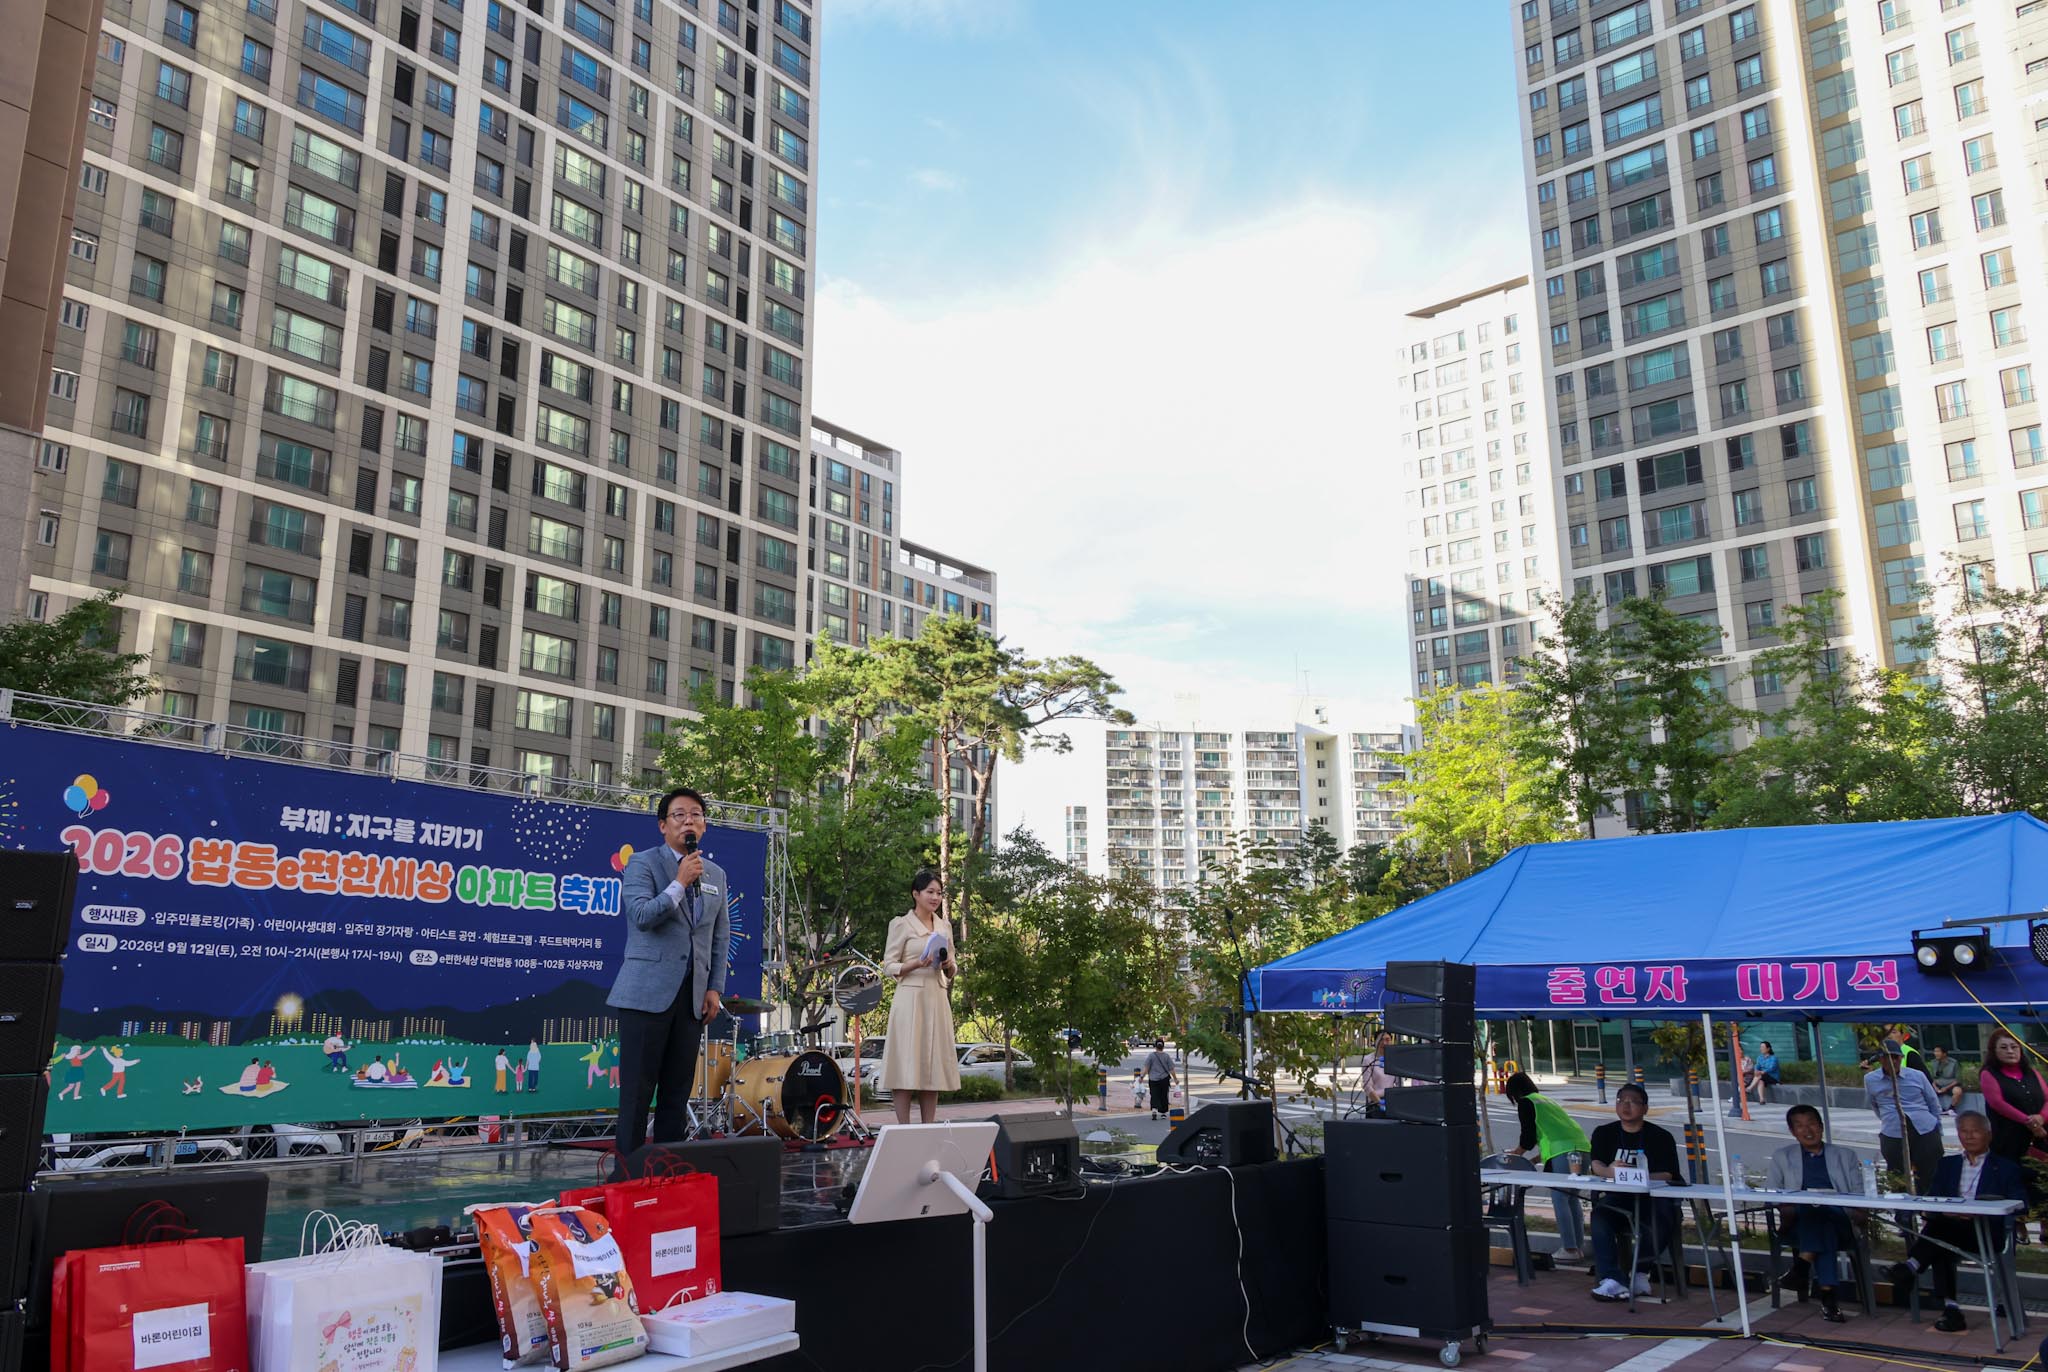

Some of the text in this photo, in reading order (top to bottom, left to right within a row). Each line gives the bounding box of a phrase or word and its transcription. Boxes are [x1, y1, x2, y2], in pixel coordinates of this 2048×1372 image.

[280, 806, 331, 835] 부제
[346, 813, 415, 844] 지구를
[419, 822, 484, 851] 지키기
[60, 825, 623, 917] 2026 법동e편한세상 아파트 축제
[89, 907, 139, 923] 행사내용
[264, 918, 336, 935] 어린이사생대회
[345, 923, 374, 936] 입주민
[376, 924, 414, 938] 장기자랑
[421, 928, 457, 940] 아티스트
[459, 930, 477, 942] 공연
[483, 932, 533, 946] 체험프로그램
[539, 936, 593, 949] 푸드트럭먹거리
[594, 938, 603, 949] 등
[85, 937, 603, 971] 일시 2026년 9월 12일(토), 오전 10시~21시(본행사 17시~19시) 장소 e편한세상 대전법동 108동~102동 지상주차장
[1546, 959, 1901, 1005] 출연자 대기석
[797, 1060, 823, 1076] Pearl
